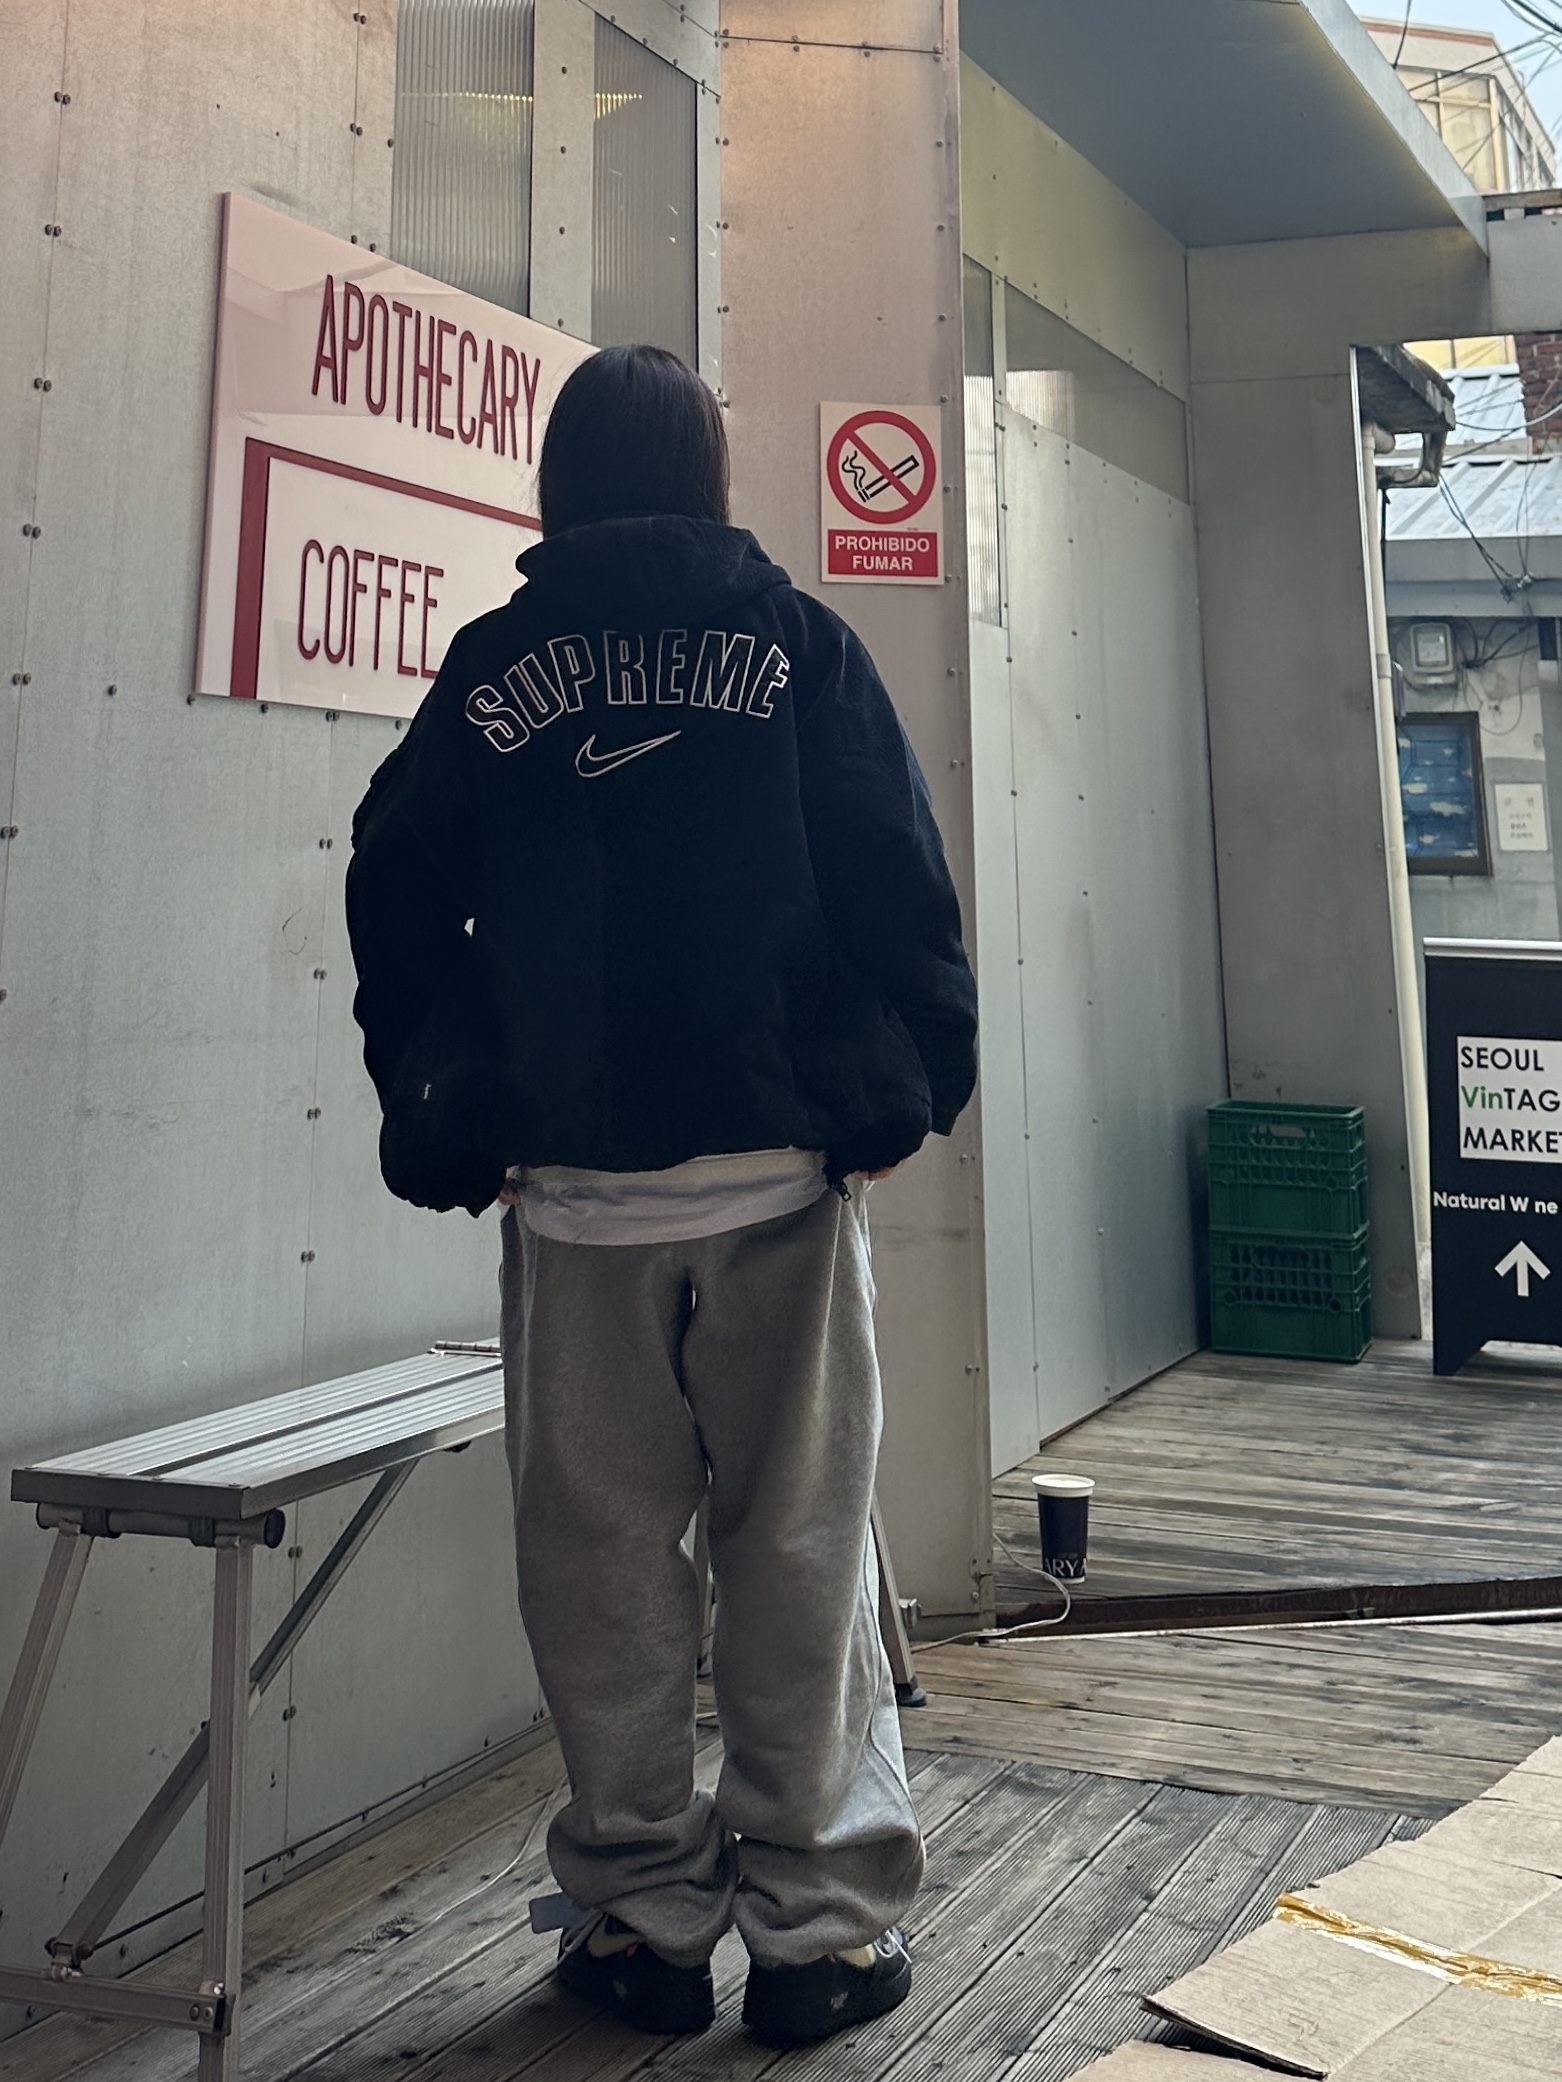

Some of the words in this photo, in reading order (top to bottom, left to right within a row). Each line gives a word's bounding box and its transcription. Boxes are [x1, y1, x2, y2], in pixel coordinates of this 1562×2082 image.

[311, 274, 541, 464] APOTHECARY
[835, 535, 930, 552] PROHIBIDO
[852, 555, 913, 571] FUMAR
[298, 539, 444, 679] COFFEE
[465, 629, 790, 752] SUPREME
[1461, 1046, 1544, 1071] SEOUL
[1464, 1126, 1562, 1153] MARKE
[1433, 1191, 1505, 1211] Natural
[1509, 1195, 1558, 1214] Wne
